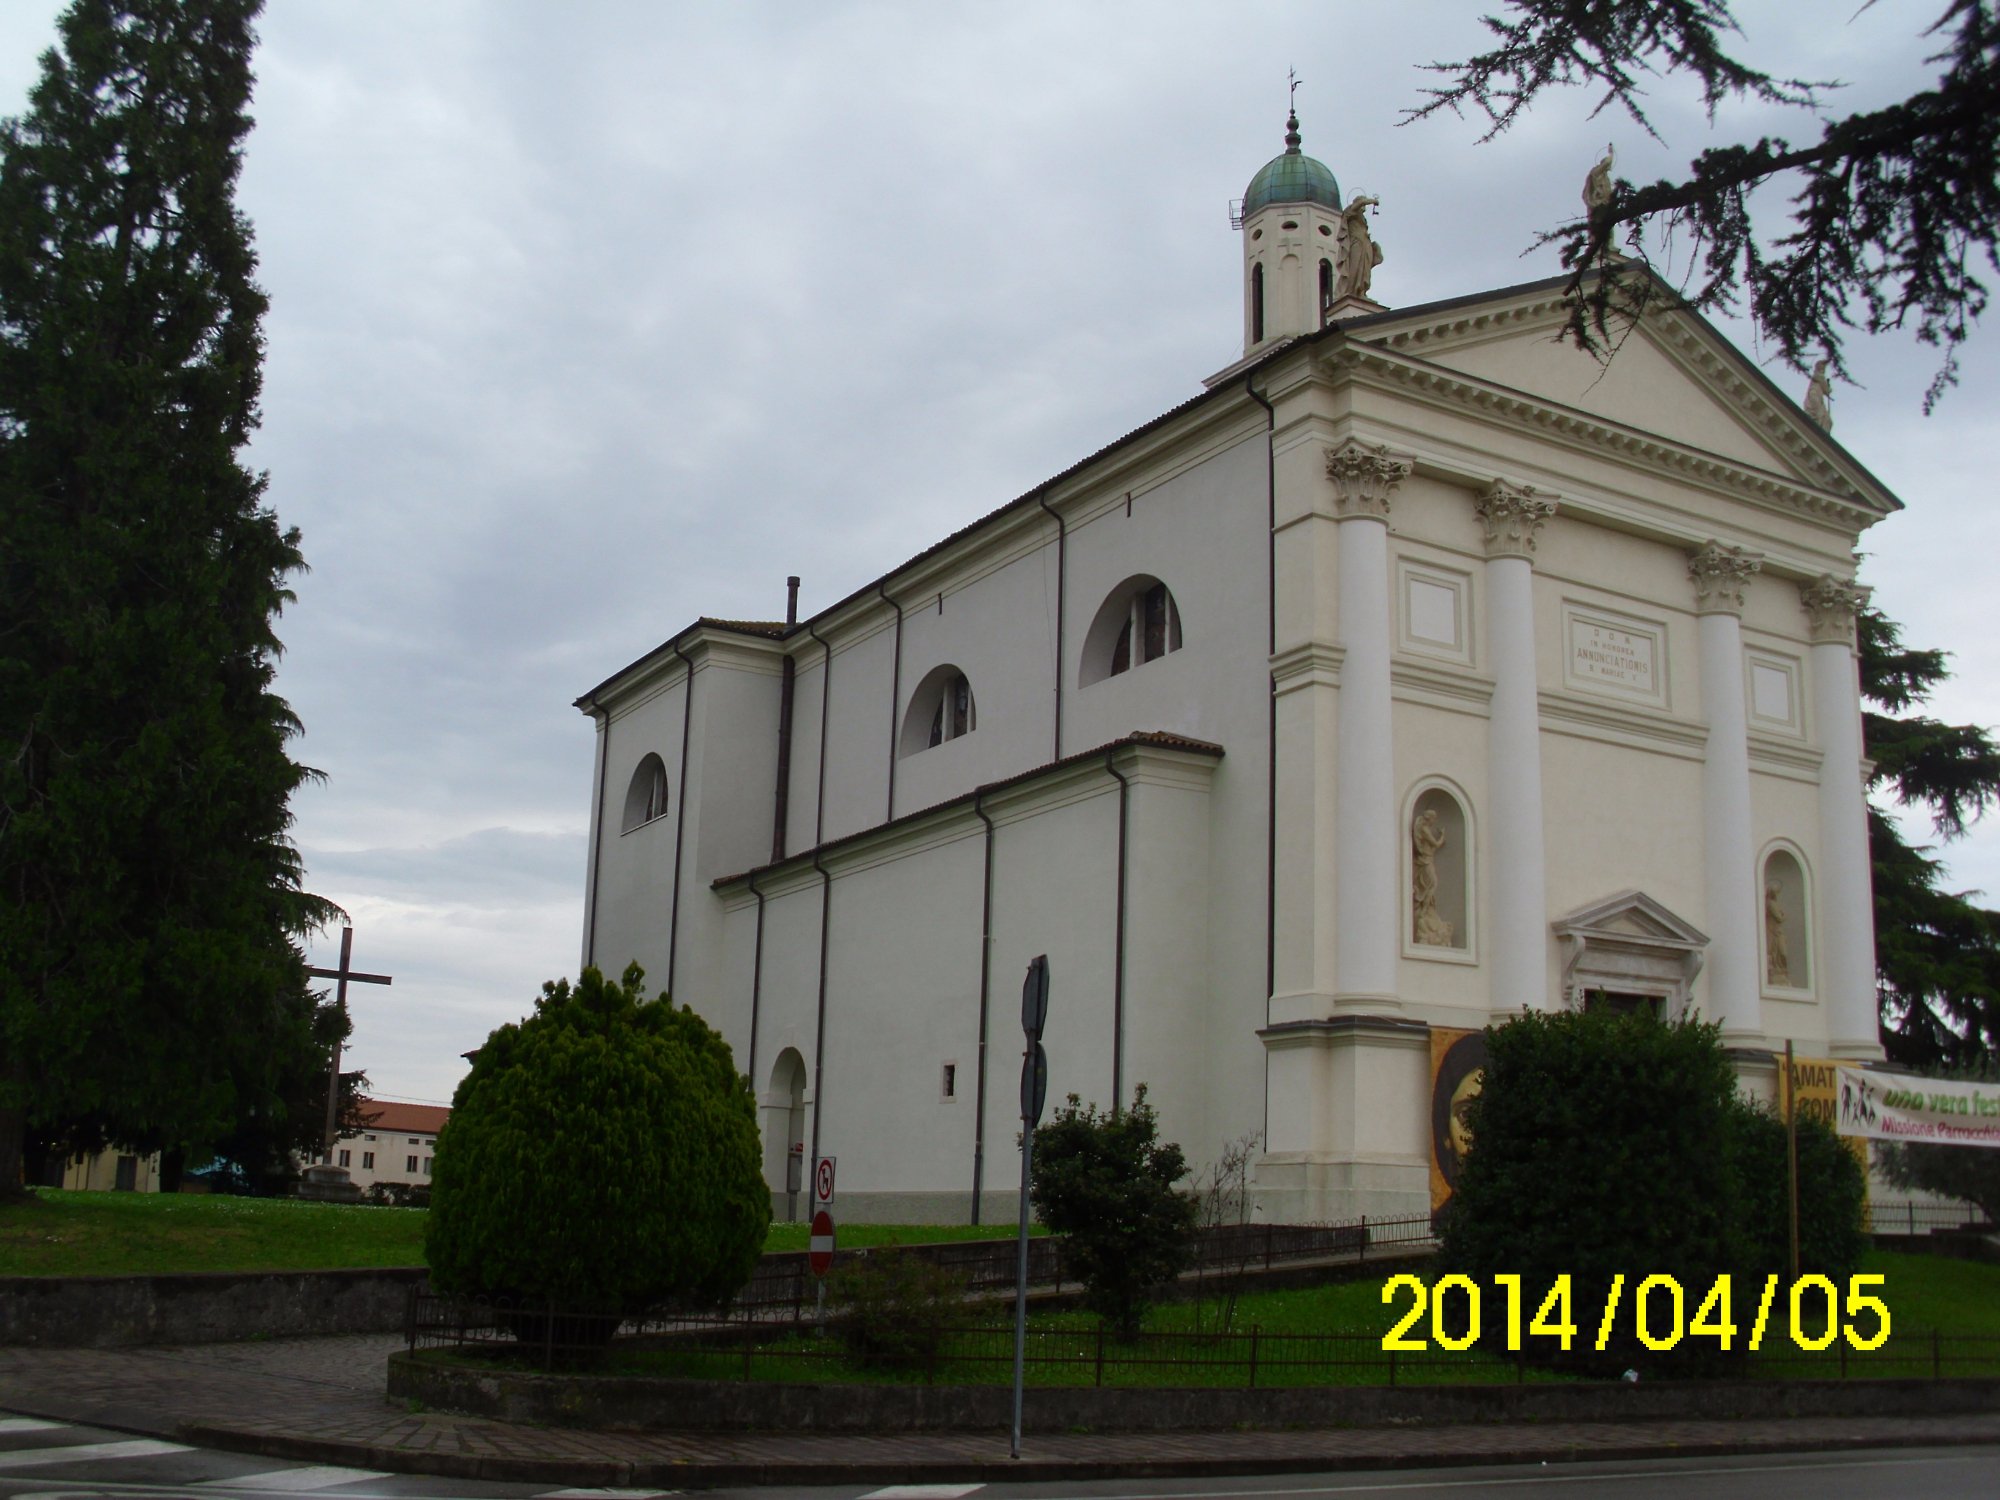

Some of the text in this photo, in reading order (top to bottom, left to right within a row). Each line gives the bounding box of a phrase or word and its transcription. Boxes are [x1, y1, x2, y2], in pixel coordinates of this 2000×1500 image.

[1577, 647, 1649, 674] ANNUNCIATIONIS
[1882, 1088, 1924, 1111] uno
[1928, 1093, 1968, 1116] vera
[1881, 1115, 1934, 1138] Missione
